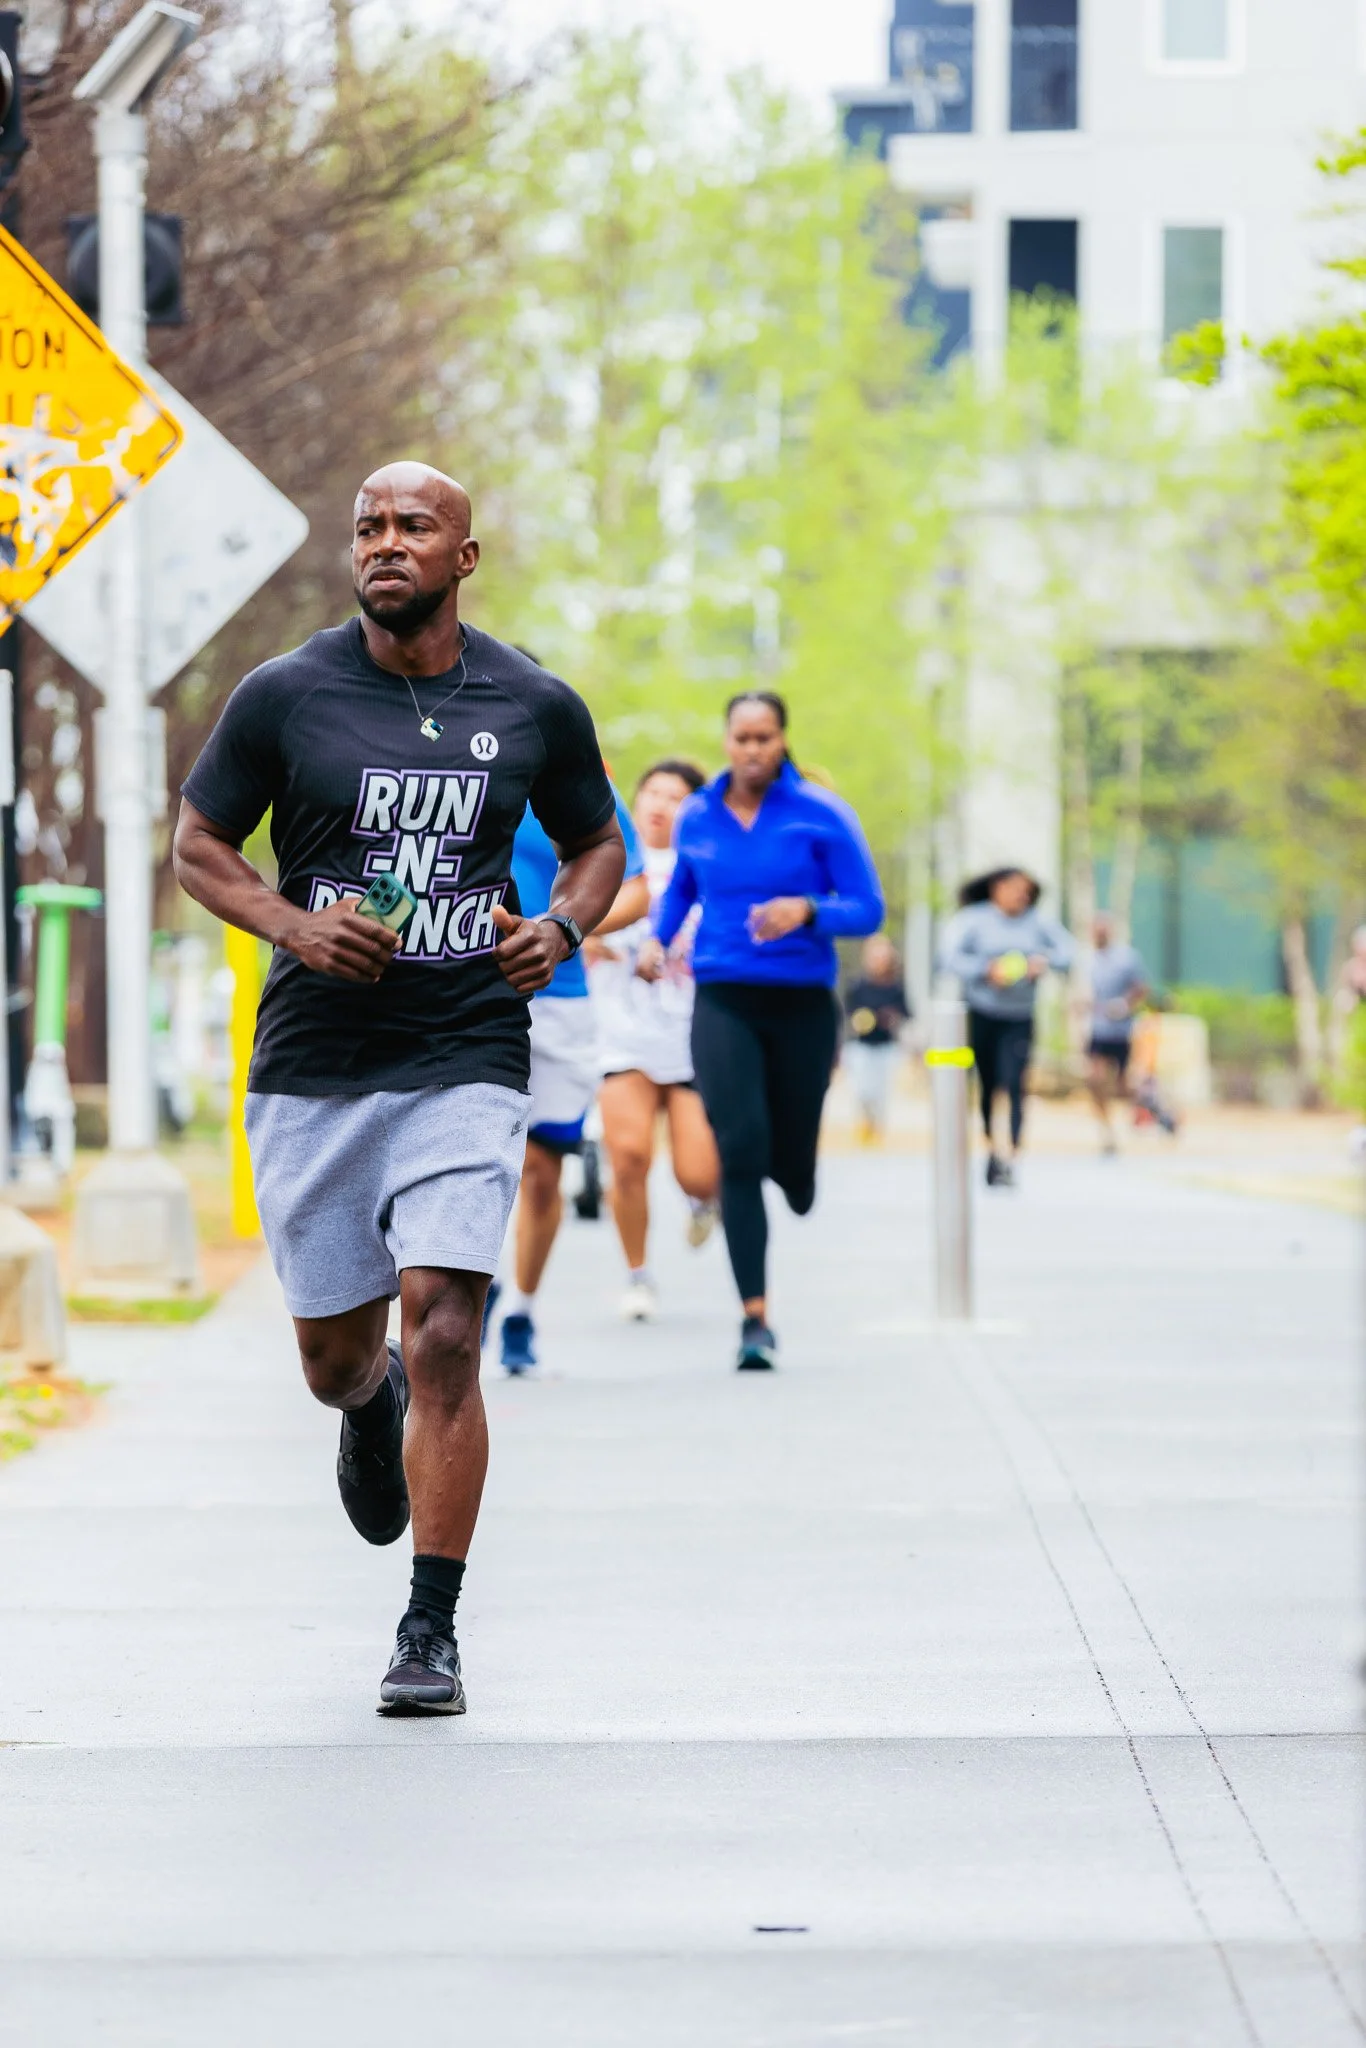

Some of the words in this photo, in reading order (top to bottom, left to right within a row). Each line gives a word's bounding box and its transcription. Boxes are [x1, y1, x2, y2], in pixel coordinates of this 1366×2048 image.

[359, 775, 481, 833] RUN
[371, 834, 455, 893] -N-
[312, 884, 501, 953] NCH
